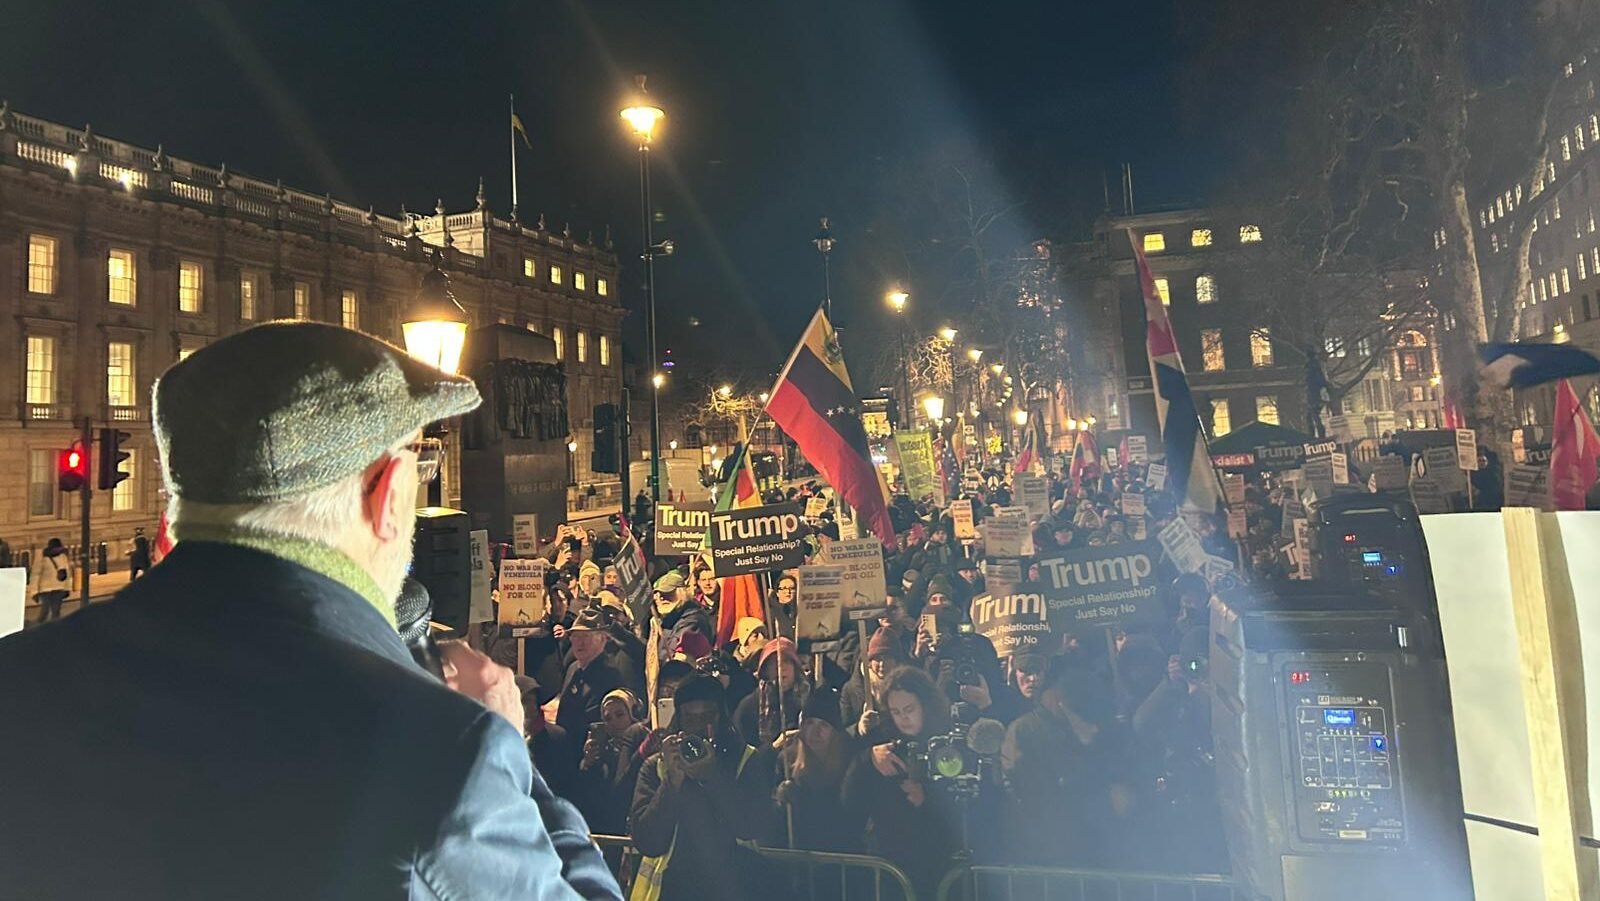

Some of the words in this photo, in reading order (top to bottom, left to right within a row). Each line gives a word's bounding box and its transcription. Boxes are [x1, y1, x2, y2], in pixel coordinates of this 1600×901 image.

[1253, 445, 1303, 459] Trump
[1304, 441, 1336, 456] Trump
[658, 505, 709, 526] Trum
[711, 513, 798, 541] Trump
[657, 531, 680, 540] Special
[687, 541, 698, 550] Say
[715, 548, 745, 558] Special
[747, 540, 800, 554] Relationship?
[735, 556, 753, 566] Just
[754, 554, 770, 565] Say
[771, 554, 783, 562] No
[849, 562, 881, 571] BLOOD
[860, 571, 876, 579] OIL
[1040, 553, 1151, 589] Trump
[507, 591, 523, 599] FOR
[1049, 597, 1085, 610] Special
[1087, 586, 1156, 604] Relationship?
[1075, 609, 1097, 620] Just
[1099, 606, 1118, 618] Say
[1120, 604, 1136, 614] No
[1004, 635, 1021, 646] Say
[1023, 635, 1037, 644] No
